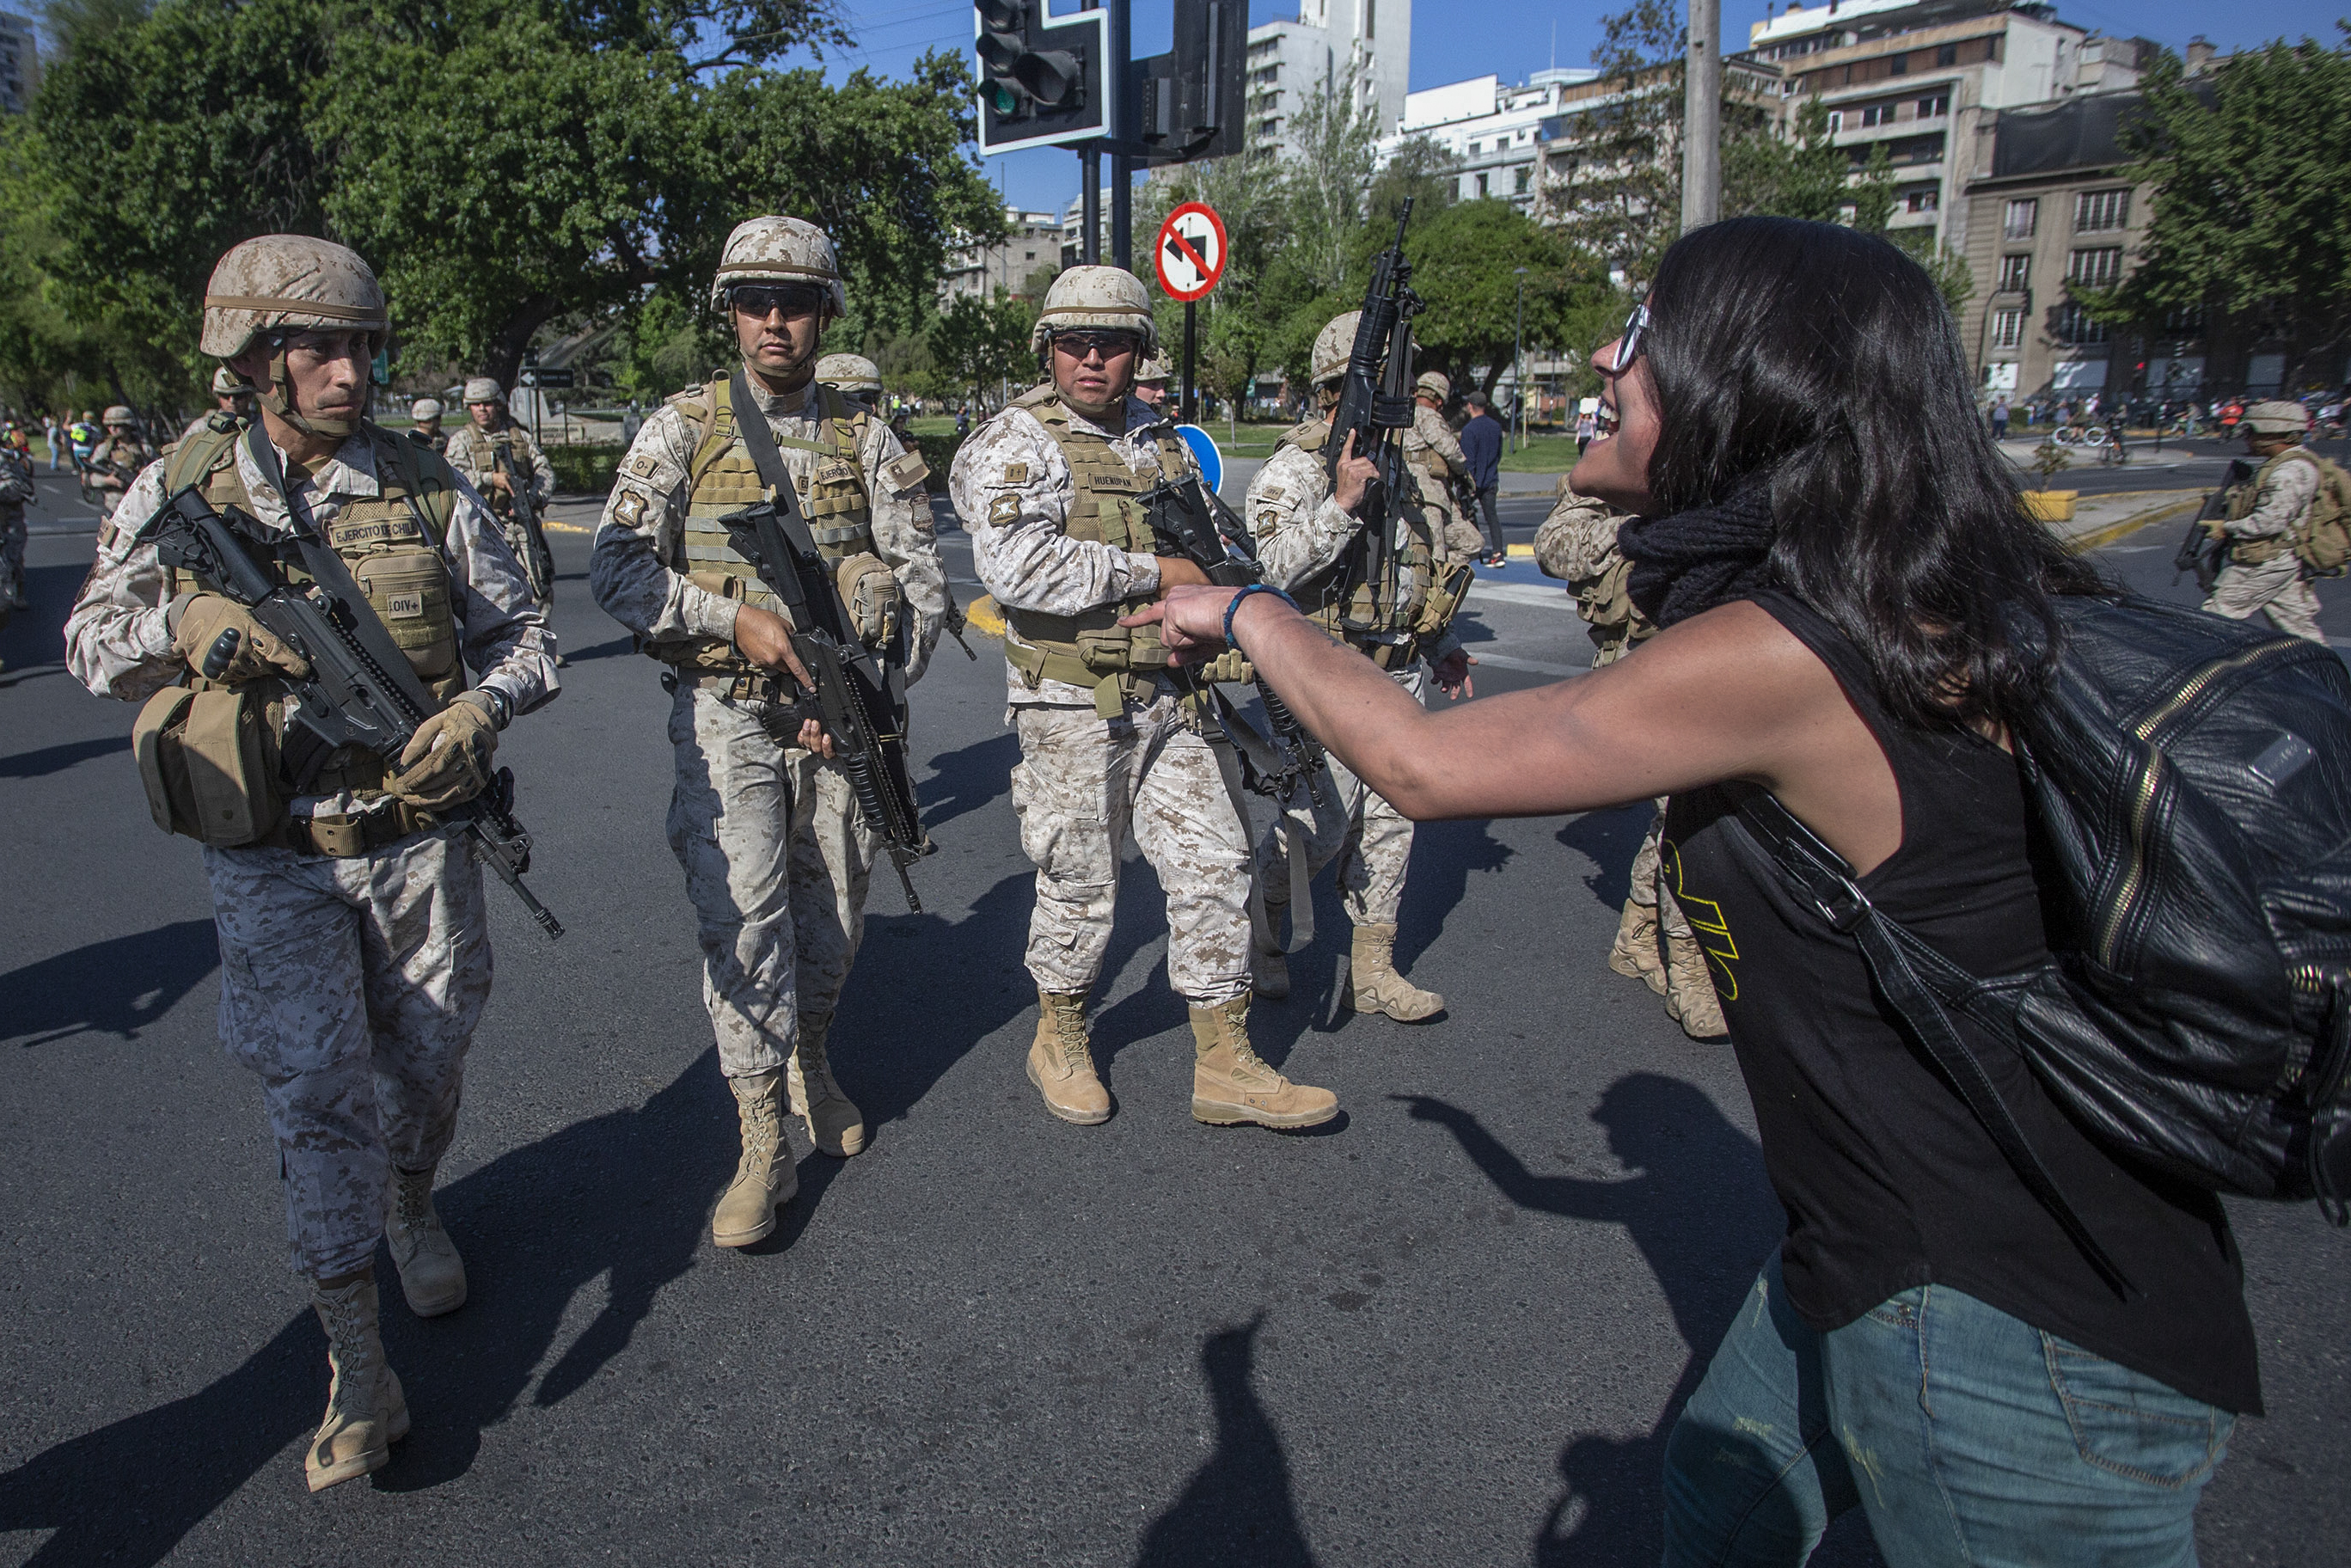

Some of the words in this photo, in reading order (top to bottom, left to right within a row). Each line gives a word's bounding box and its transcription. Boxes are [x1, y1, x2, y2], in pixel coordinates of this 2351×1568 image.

[1094, 476, 1132, 487] HUENUPAN
[336, 525, 380, 542] EJERCITO
[381, 524, 391, 536] DE
